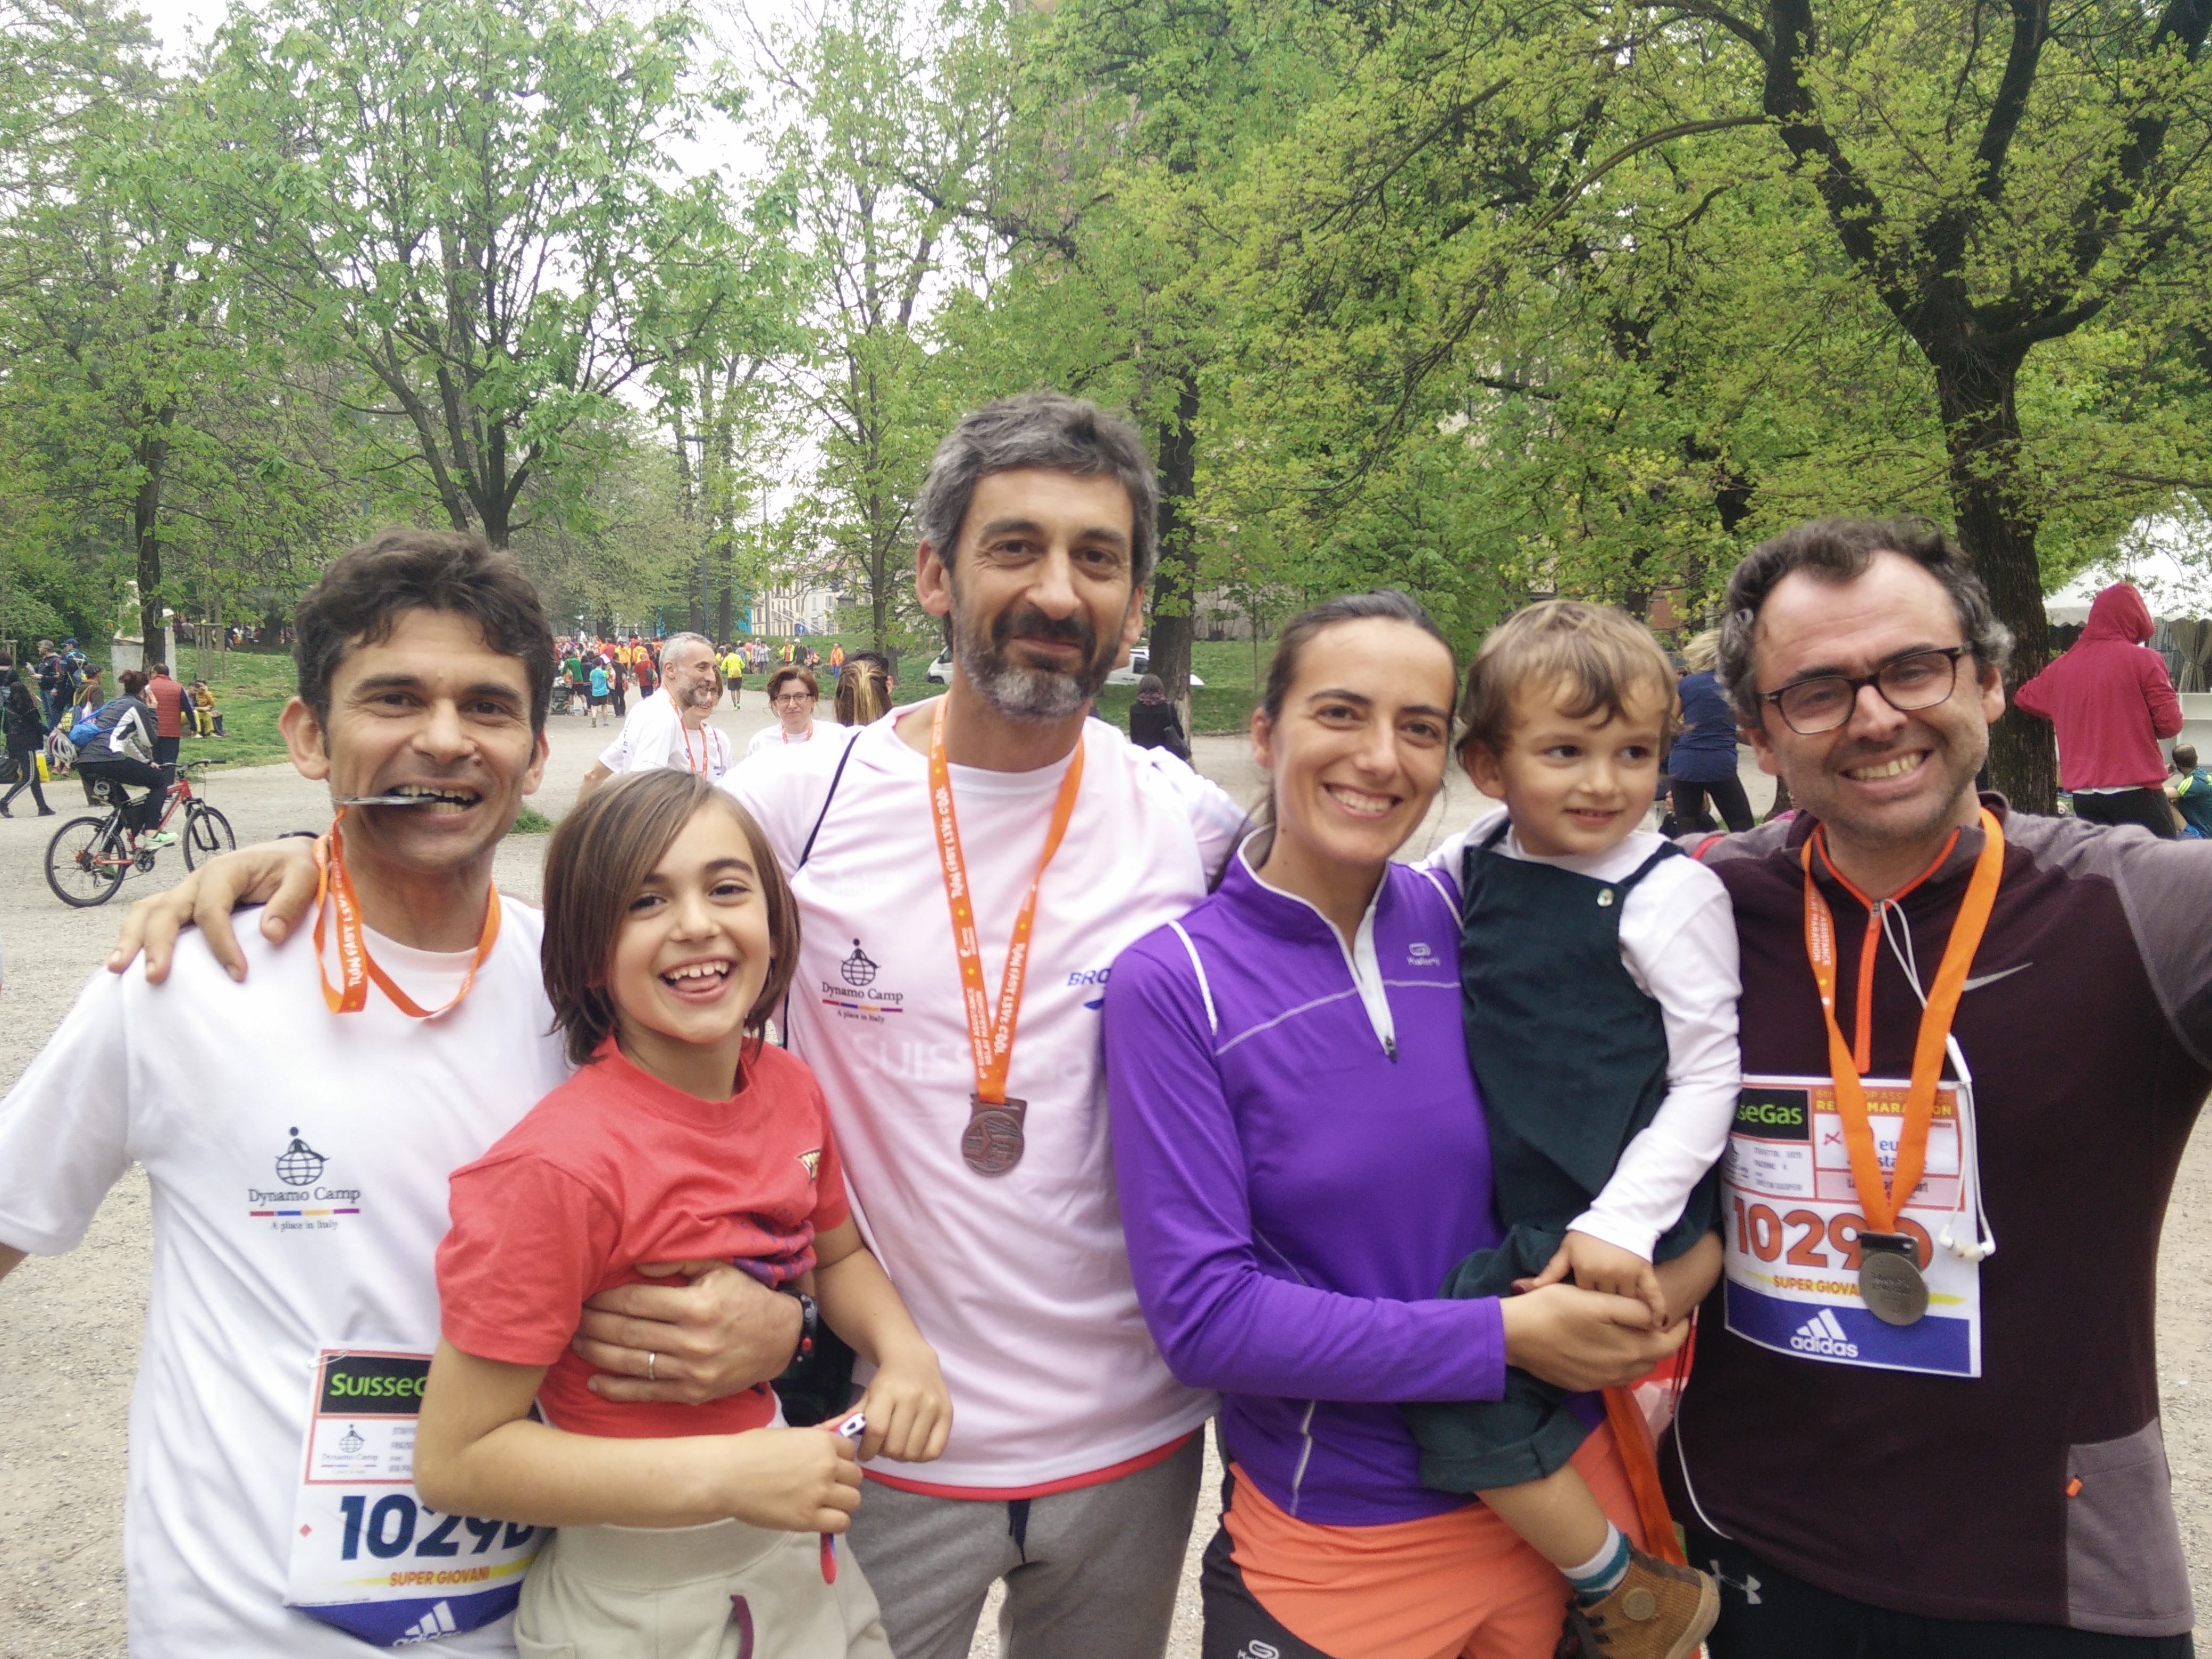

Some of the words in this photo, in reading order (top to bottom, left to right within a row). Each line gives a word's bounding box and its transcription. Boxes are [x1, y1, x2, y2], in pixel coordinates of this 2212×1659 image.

[1068, 968, 1112, 986] BRO
[822, 982, 865, 999] Dynamo
[867, 988, 904, 1004] Camp
[843, 1011, 860, 1021] place
[869, 1015, 885, 1024] Italy
[1736, 1104, 1803, 1125] seGas
[248, 1188, 311, 1206] Dynamo
[314, 1187, 361, 1204] Camp
[280, 1221, 303, 1232] place
[316, 1220, 339, 1230] Italy
[1773, 1275, 1813, 1292] SUPER
[1816, 1279, 1862, 1296] GIOVA
[1790, 1335, 1858, 1359] adidas
[390, 1571, 433, 1587] SUPER
[437, 1565, 490, 1585] GIOVANI
